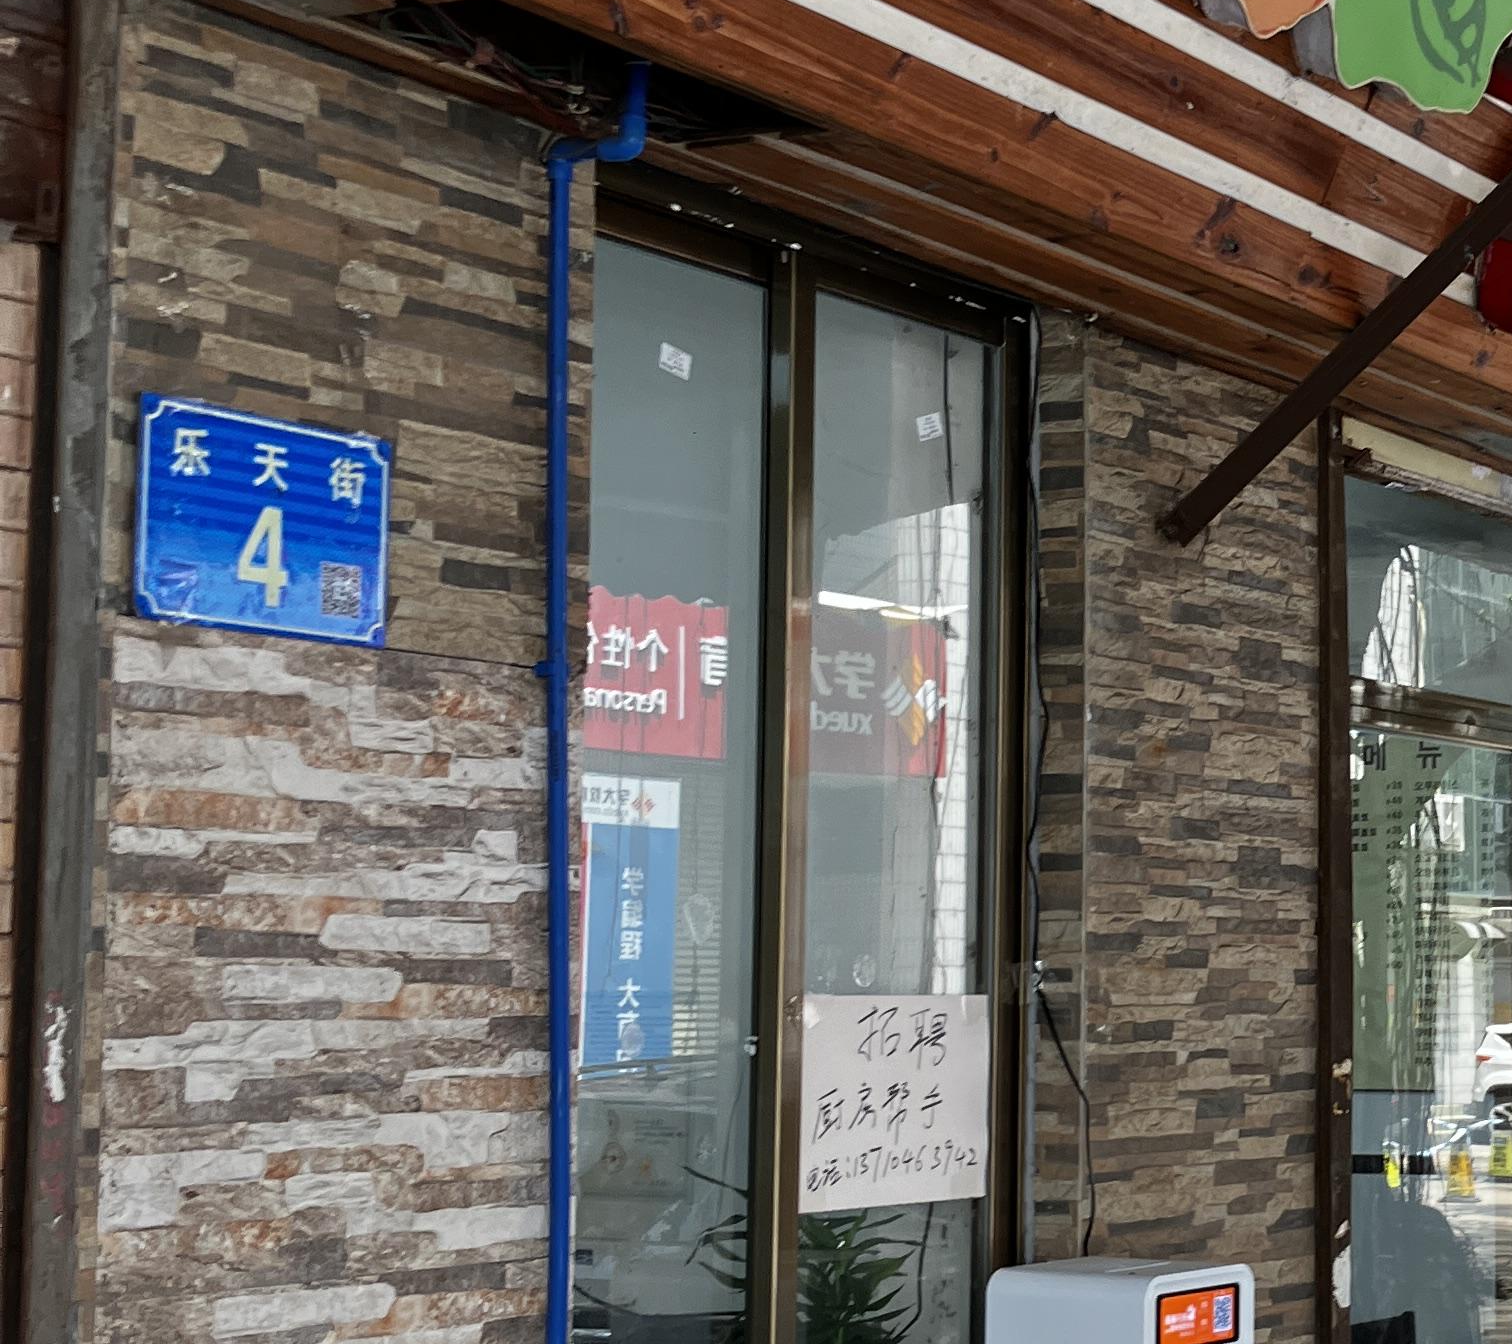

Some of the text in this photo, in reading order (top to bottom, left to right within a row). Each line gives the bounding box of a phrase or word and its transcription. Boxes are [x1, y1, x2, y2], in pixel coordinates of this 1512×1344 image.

[170, 427, 366, 508] 乐天街
[236, 506, 289, 609] 4
[857, 1006, 948, 1070] 招聘
